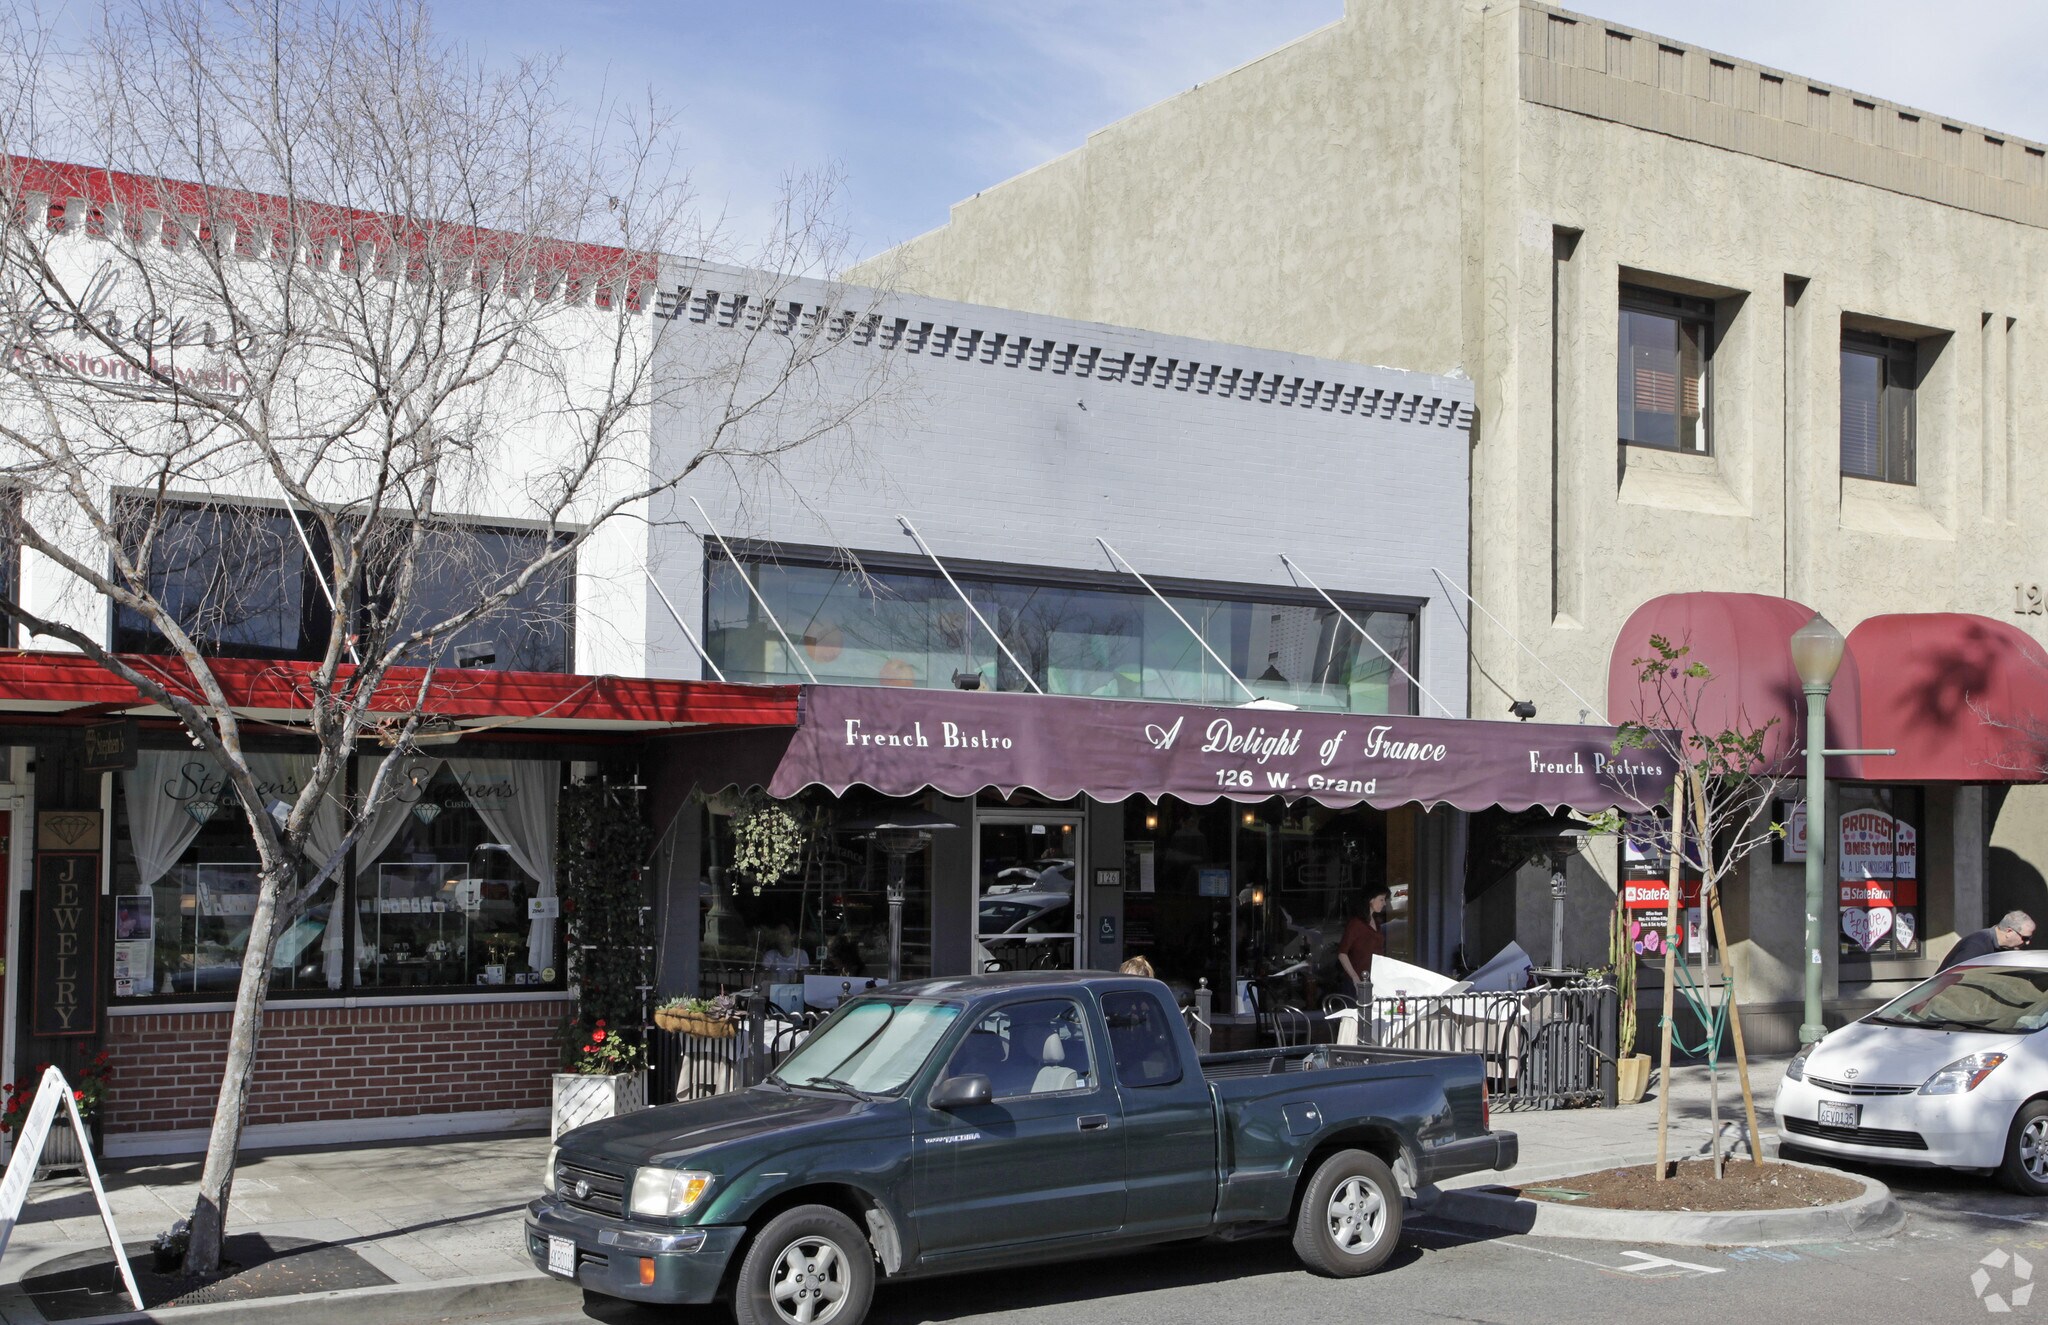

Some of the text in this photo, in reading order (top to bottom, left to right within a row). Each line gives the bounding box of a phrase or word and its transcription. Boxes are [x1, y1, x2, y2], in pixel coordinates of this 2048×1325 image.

[2013, 582, 2048, 616] 12
[845, 719, 1013, 749] French Bistro
[1144, 716, 1448, 766] A Delight of France
[1529, 750, 1662, 776] French Pastries
[164, 762, 300, 800] Steen's
[1216, 769, 1377, 794] 126 W. Grand
[1842, 813, 1894, 842] PROTECT
[1844, 842, 1871, 856] ONES
[52, 858, 84, 1030] JEWELRY
[945, 1133, 981, 1143] TACOMA
